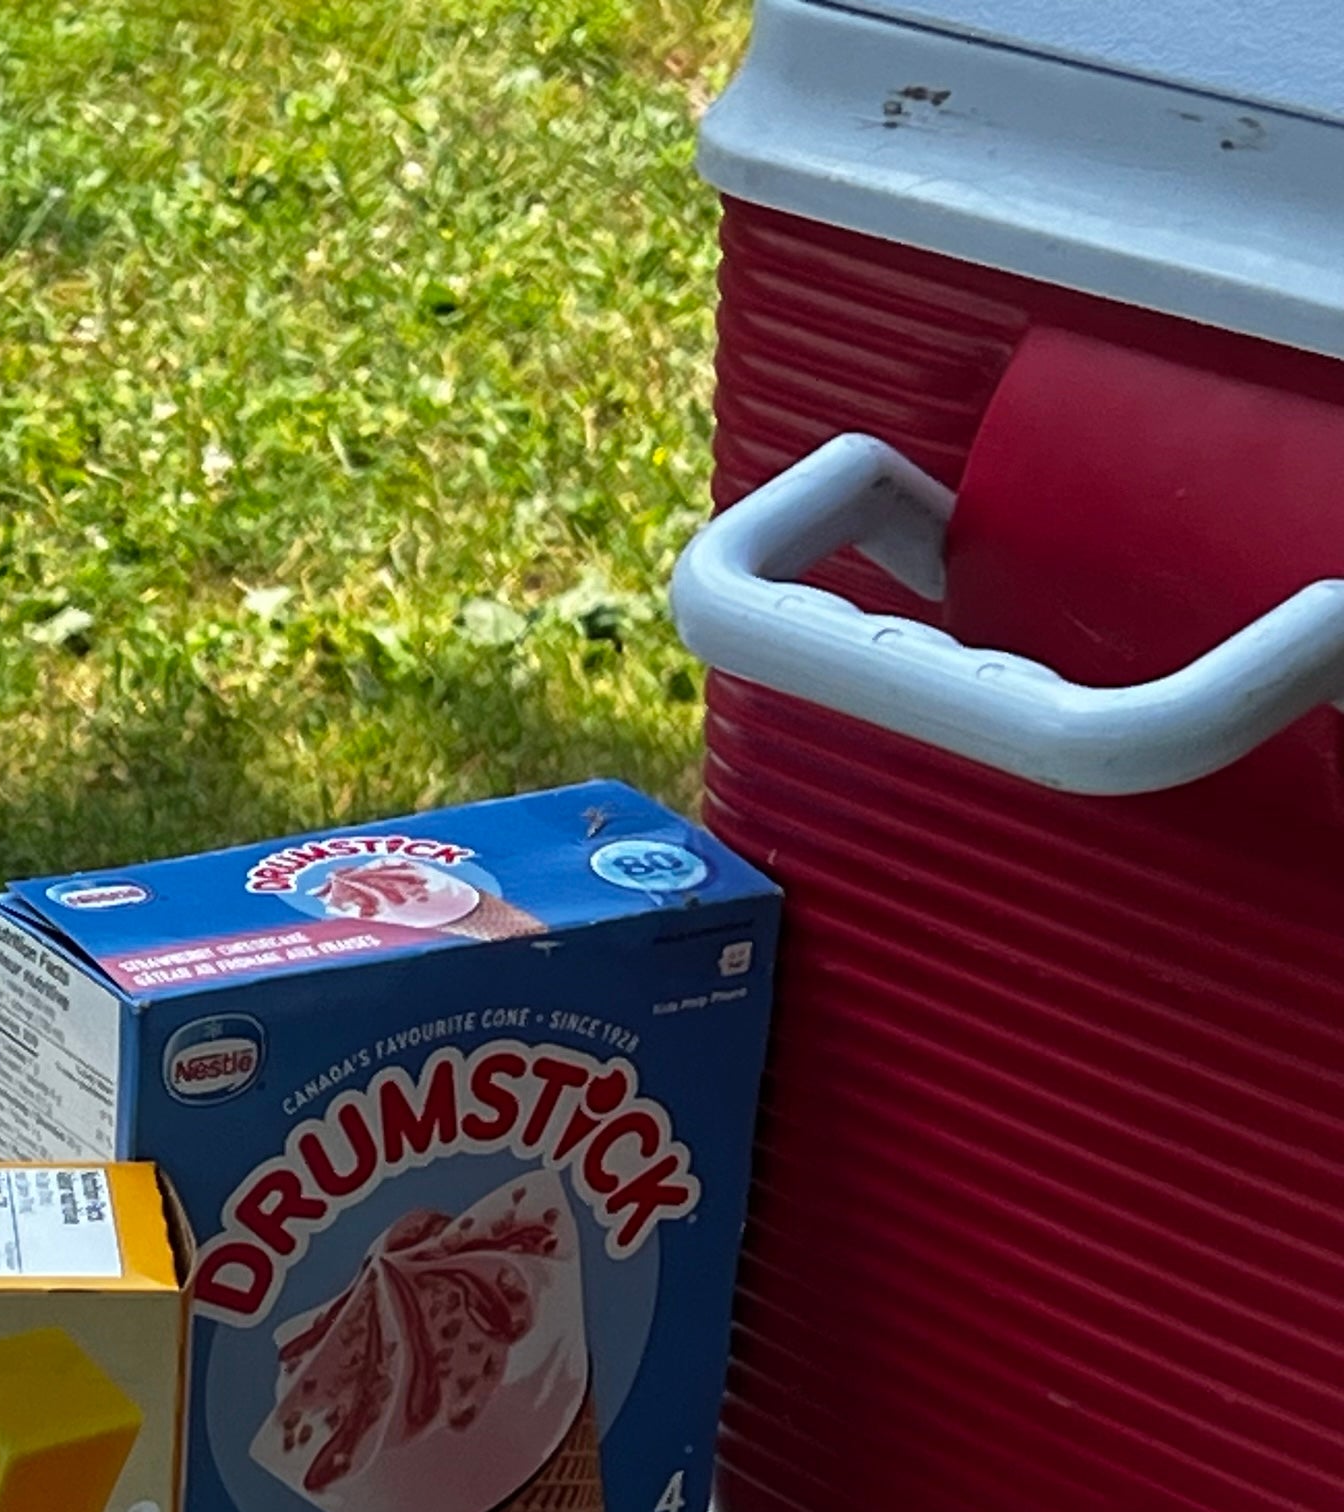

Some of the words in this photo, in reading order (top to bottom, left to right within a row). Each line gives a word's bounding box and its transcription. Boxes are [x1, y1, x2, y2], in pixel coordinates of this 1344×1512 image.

[248, 837, 477, 893] DRUMSTICK
[612, 850, 683, 877] 80
[281, 1046, 372, 1116] CANADA'S
[375, 1010, 477, 1062] FAVOURITE
[480, 1006, 530, 1034] CONE
[547, 1009, 597, 1040] SINCE
[600, 1022, 642, 1054] 1928
[192, 1047, 694, 1320] DRUMSTICK
